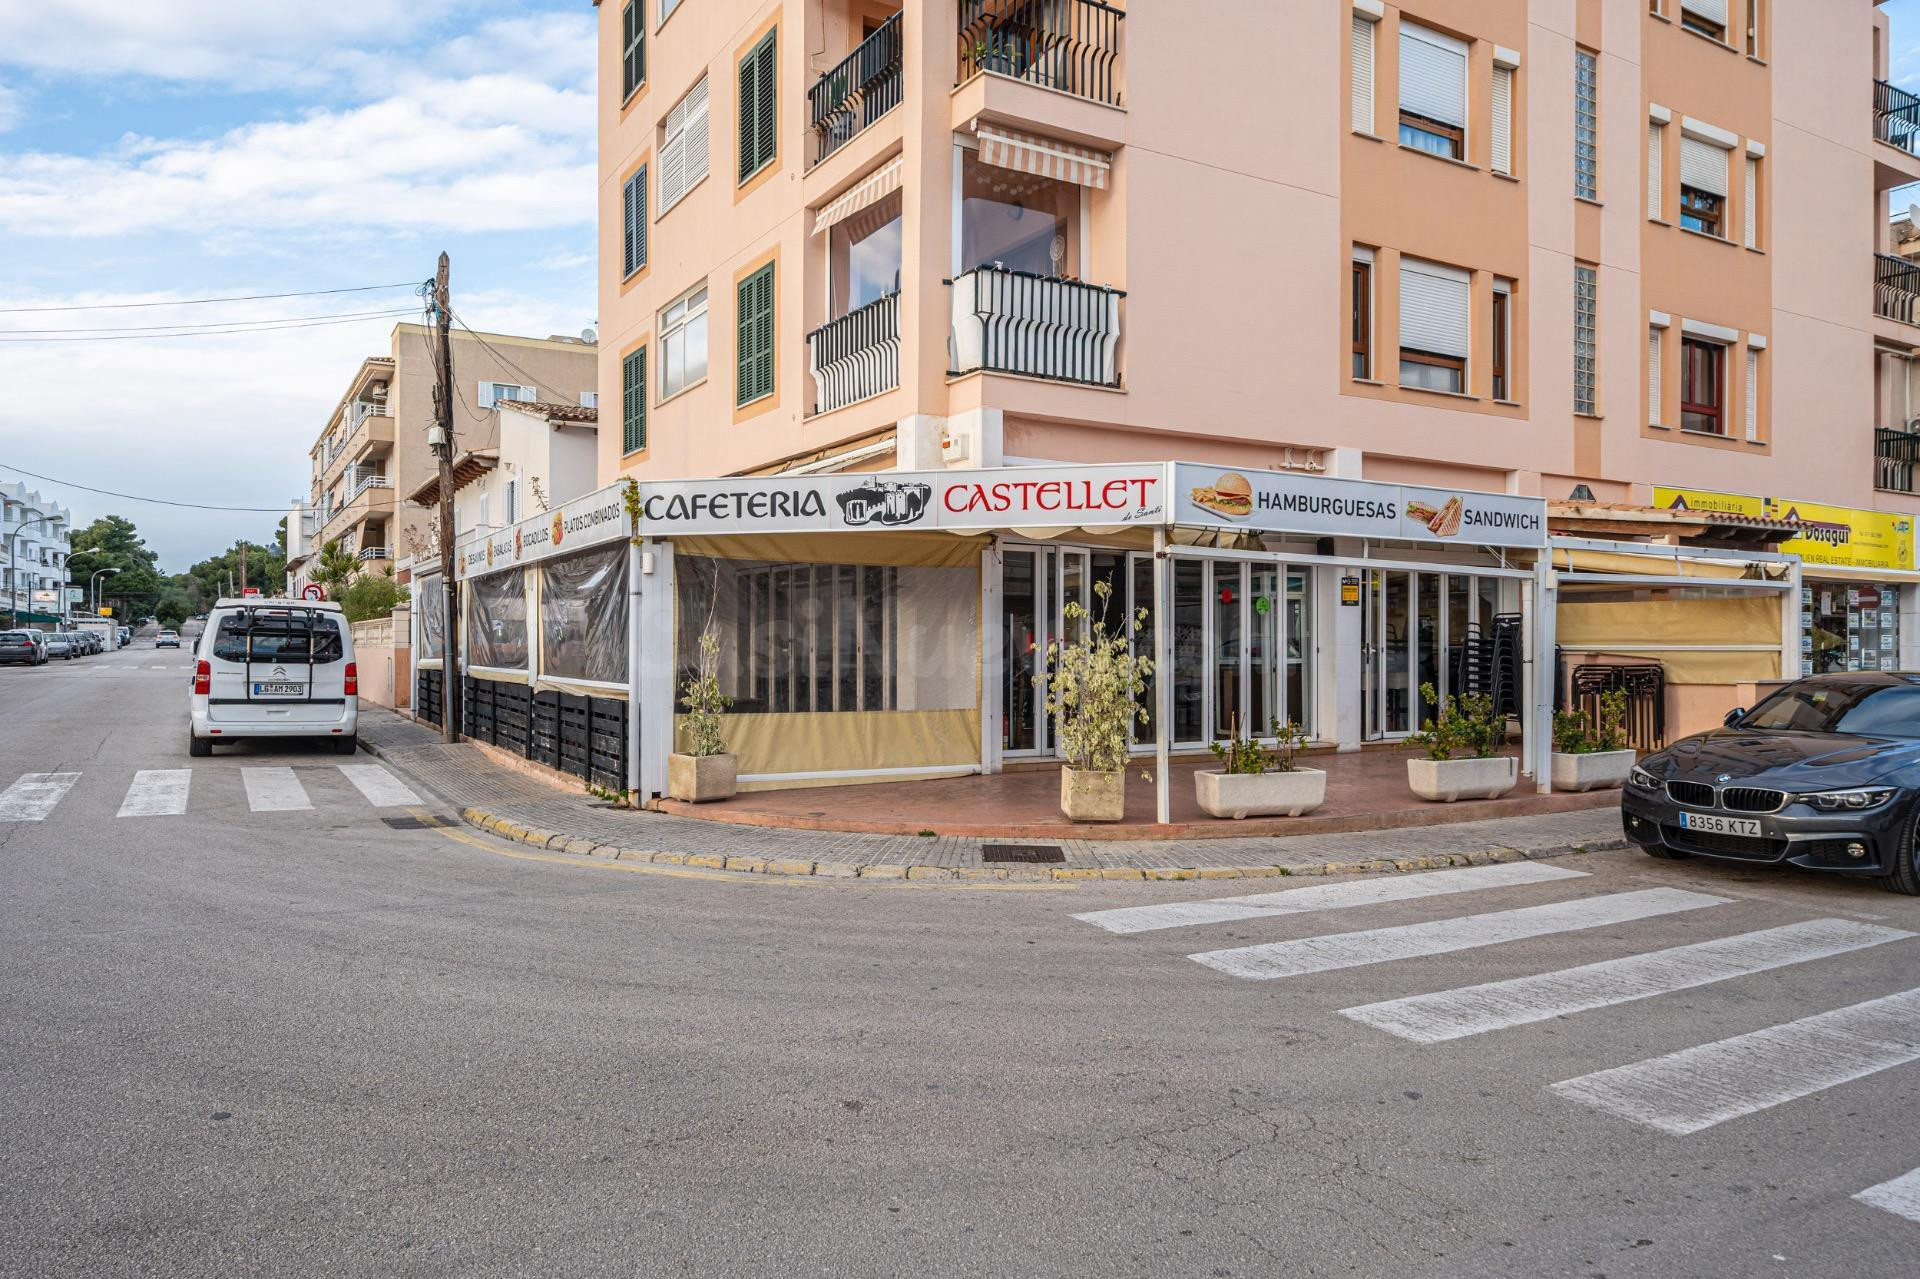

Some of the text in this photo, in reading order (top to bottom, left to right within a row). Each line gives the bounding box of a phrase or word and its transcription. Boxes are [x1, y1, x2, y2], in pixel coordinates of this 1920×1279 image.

[644, 489, 827, 521] CAFETERIA
[943, 478, 1159, 513] CASTELLET
[1258, 491, 1397, 520] HAMBURGUESAS
[564, 502, 621, 534] PLATOS COMBINADOS
[1463, 509, 1539, 530] SANDWICH
[1816, 554, 1829, 565] REAL
[1831, 556, 1852, 567] ESTATE
[285, 685, 302, 693] 2903
[1689, 815, 1758, 835] 8356 KTZ
